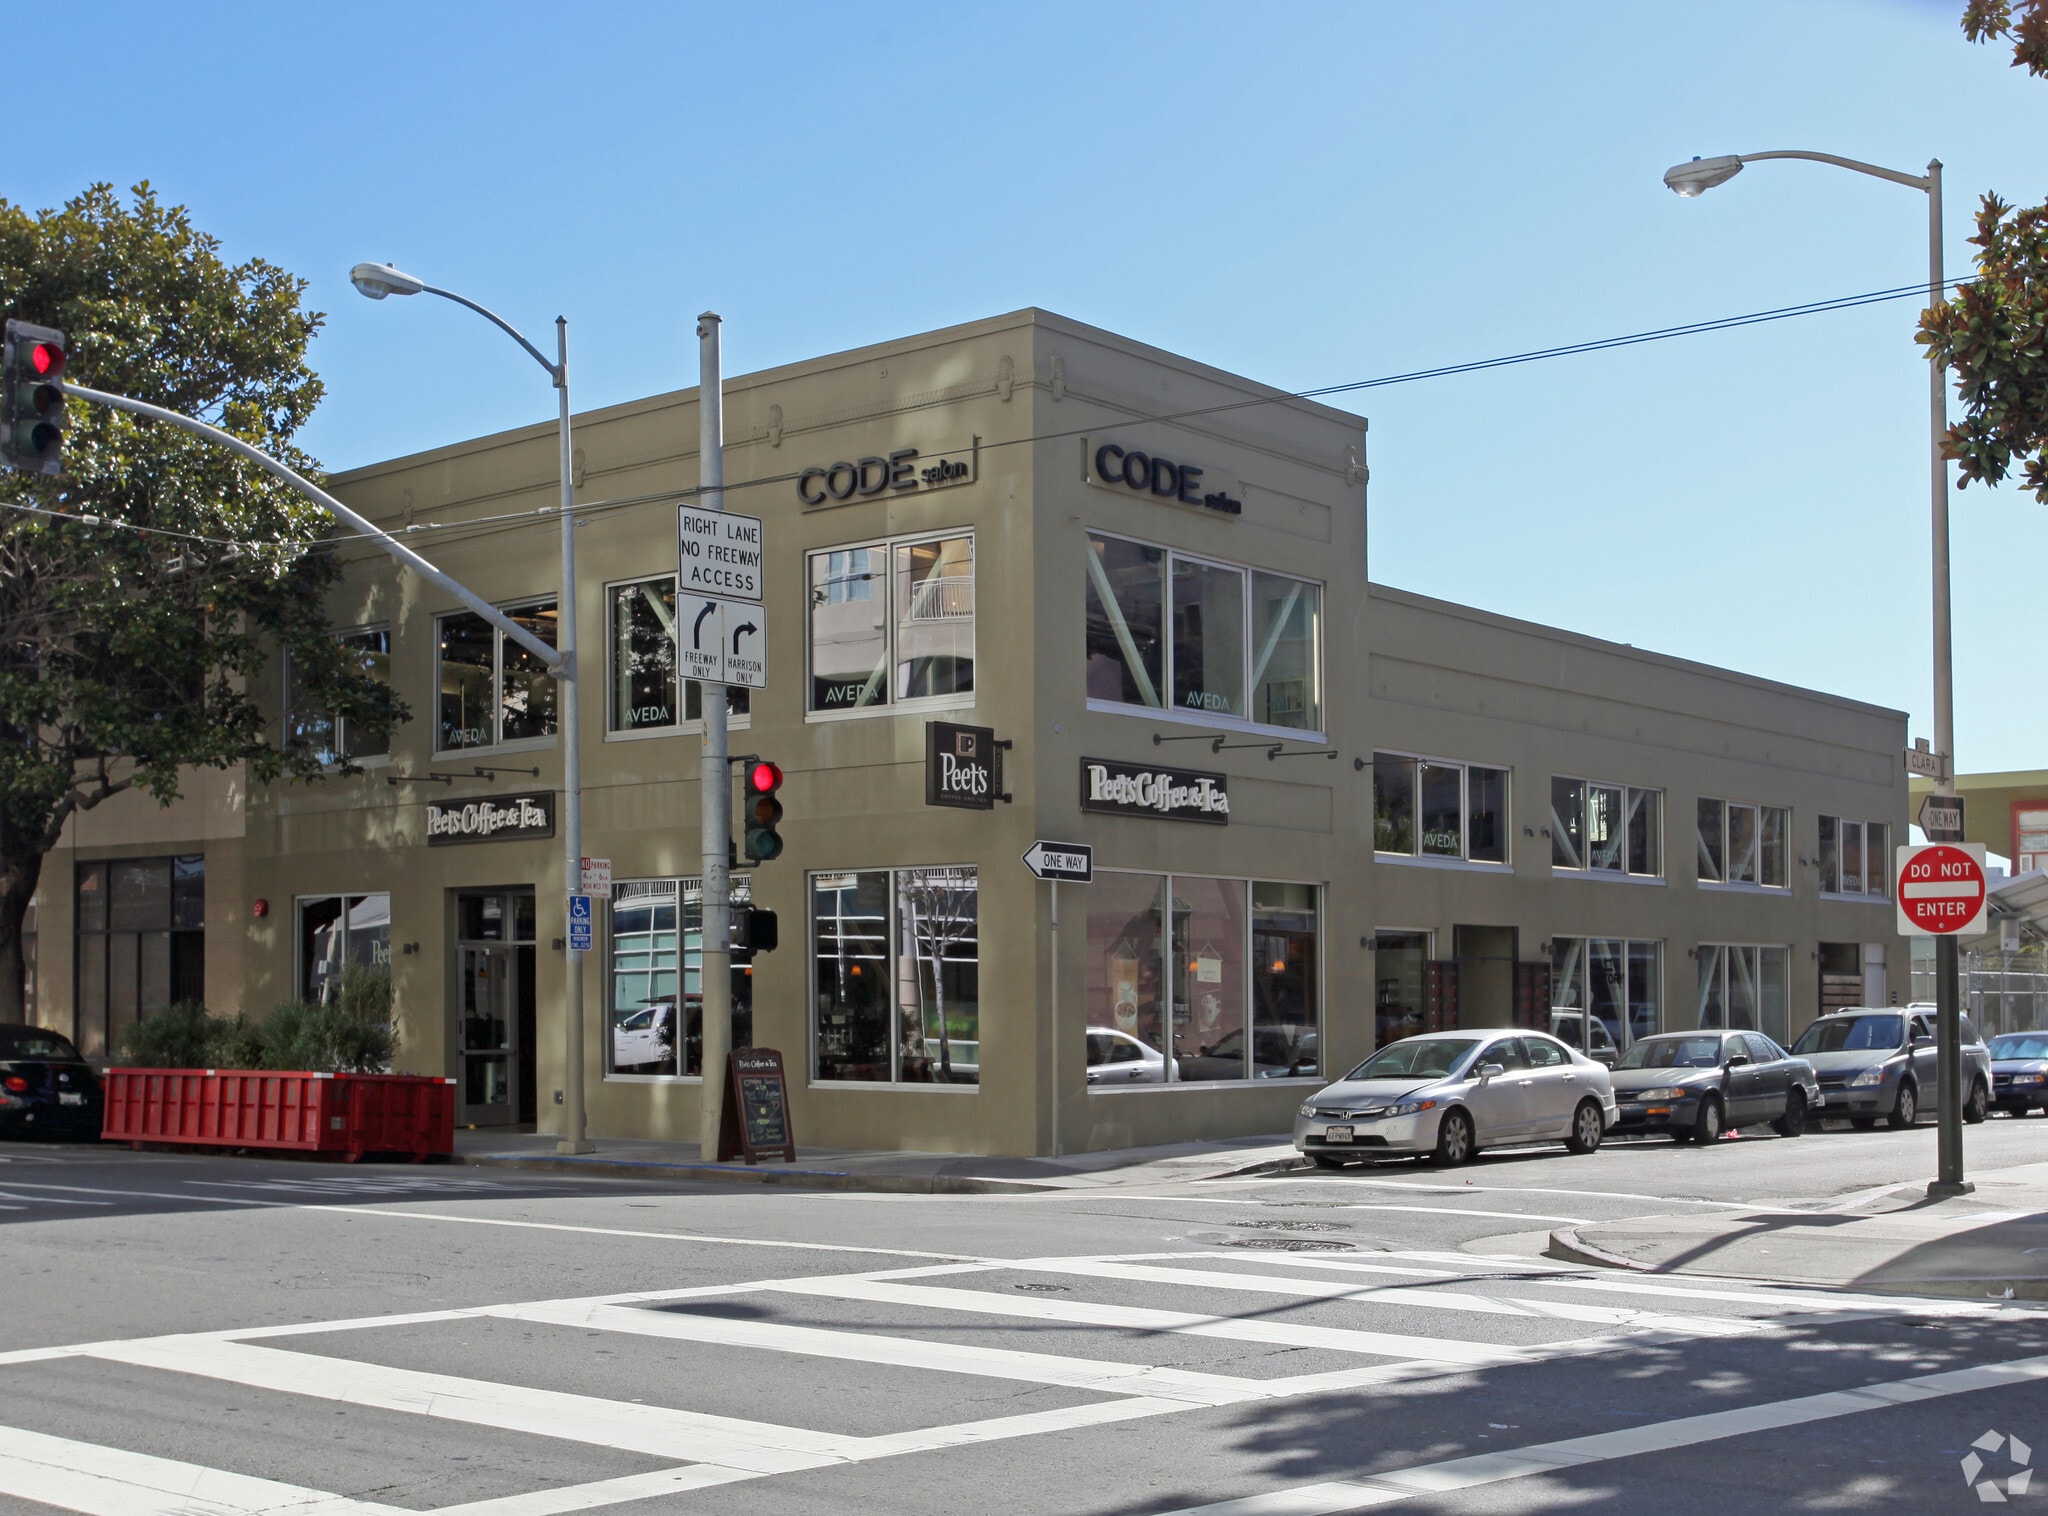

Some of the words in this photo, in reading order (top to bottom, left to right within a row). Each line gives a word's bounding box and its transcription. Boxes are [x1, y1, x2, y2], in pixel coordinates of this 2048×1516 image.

[797, 448, 918, 505] CODE
[921, 458, 968, 482] salon
[1095, 444, 1203, 505] CODE
[684, 516, 718, 536] RIGHT
[727, 523, 758, 544] LANE
[681, 539, 700, 557] NO
[708, 544, 760, 568] FREEWAY
[691, 566, 754, 591] ACCESS
[685, 651, 718, 666] FREEWAY
[727, 657, 762, 673] HARRISON
[692, 665, 711, 678] ONLY
[736, 671, 753, 684] ONLY
[1186, 690, 1230, 711] AVEDA
[624, 705, 669, 723] AVEDA
[447, 727, 487, 744] AVEDA
[1911, 754, 1937, 772] CLARA
[940, 753, 988, 796] Peet's
[1135, 772, 1188, 812] Coffee
[1187, 786, 1204, 807] &
[1195, 778, 1229, 813] Tea
[461, 802, 507, 835] Coffee
[505, 808, 519, 826] &
[515, 799, 547, 828] Tea
[1930, 809, 1943, 827] ONE
[1943, 809, 1960, 828] WAY
[1423, 833, 1458, 849] AVEDA
[581, 859, 590, 869] NO
[590, 861, 610, 870] PARKING
[1044, 853, 1062, 868] ONE
[1065, 855, 1083, 870] WAY
[1911, 864, 1930, 878] DO
[1941, 863, 1971, 877] NOT
[1917, 902, 1966, 917] ENTER
[571, 917, 590, 925] PARKING
[574, 926, 586, 934] ONLY
